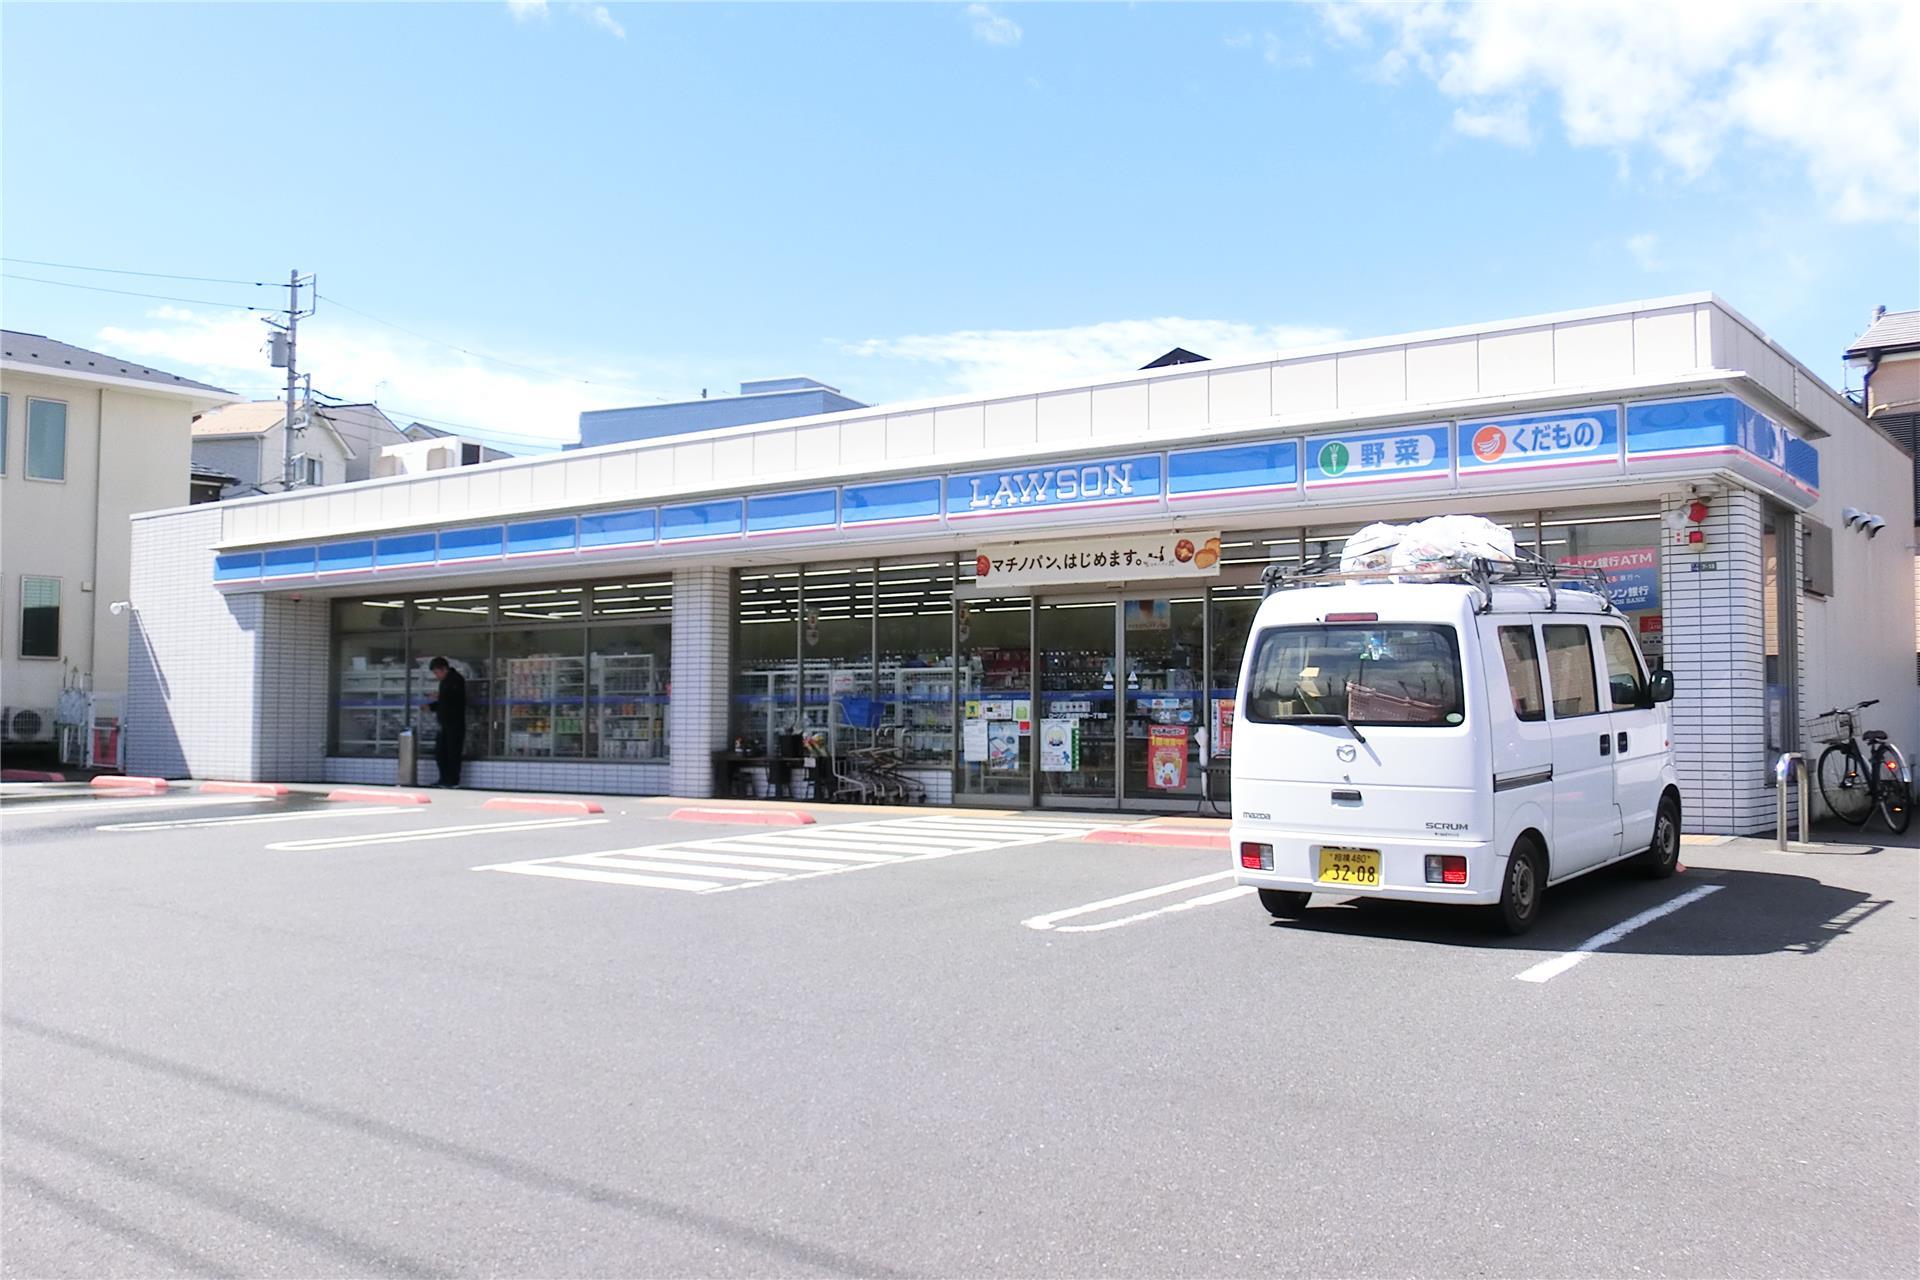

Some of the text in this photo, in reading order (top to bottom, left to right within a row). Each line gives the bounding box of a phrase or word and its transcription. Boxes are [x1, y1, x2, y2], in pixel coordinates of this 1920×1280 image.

[1511, 422, 1595, 453] くだもの
[1360, 438, 1420, 468] 野菜
[969, 462, 1134, 509] LAWSON
[991, 549, 1143, 573] マチノパン、はじめます。
[1425, 821, 1469, 831] SCRUM
